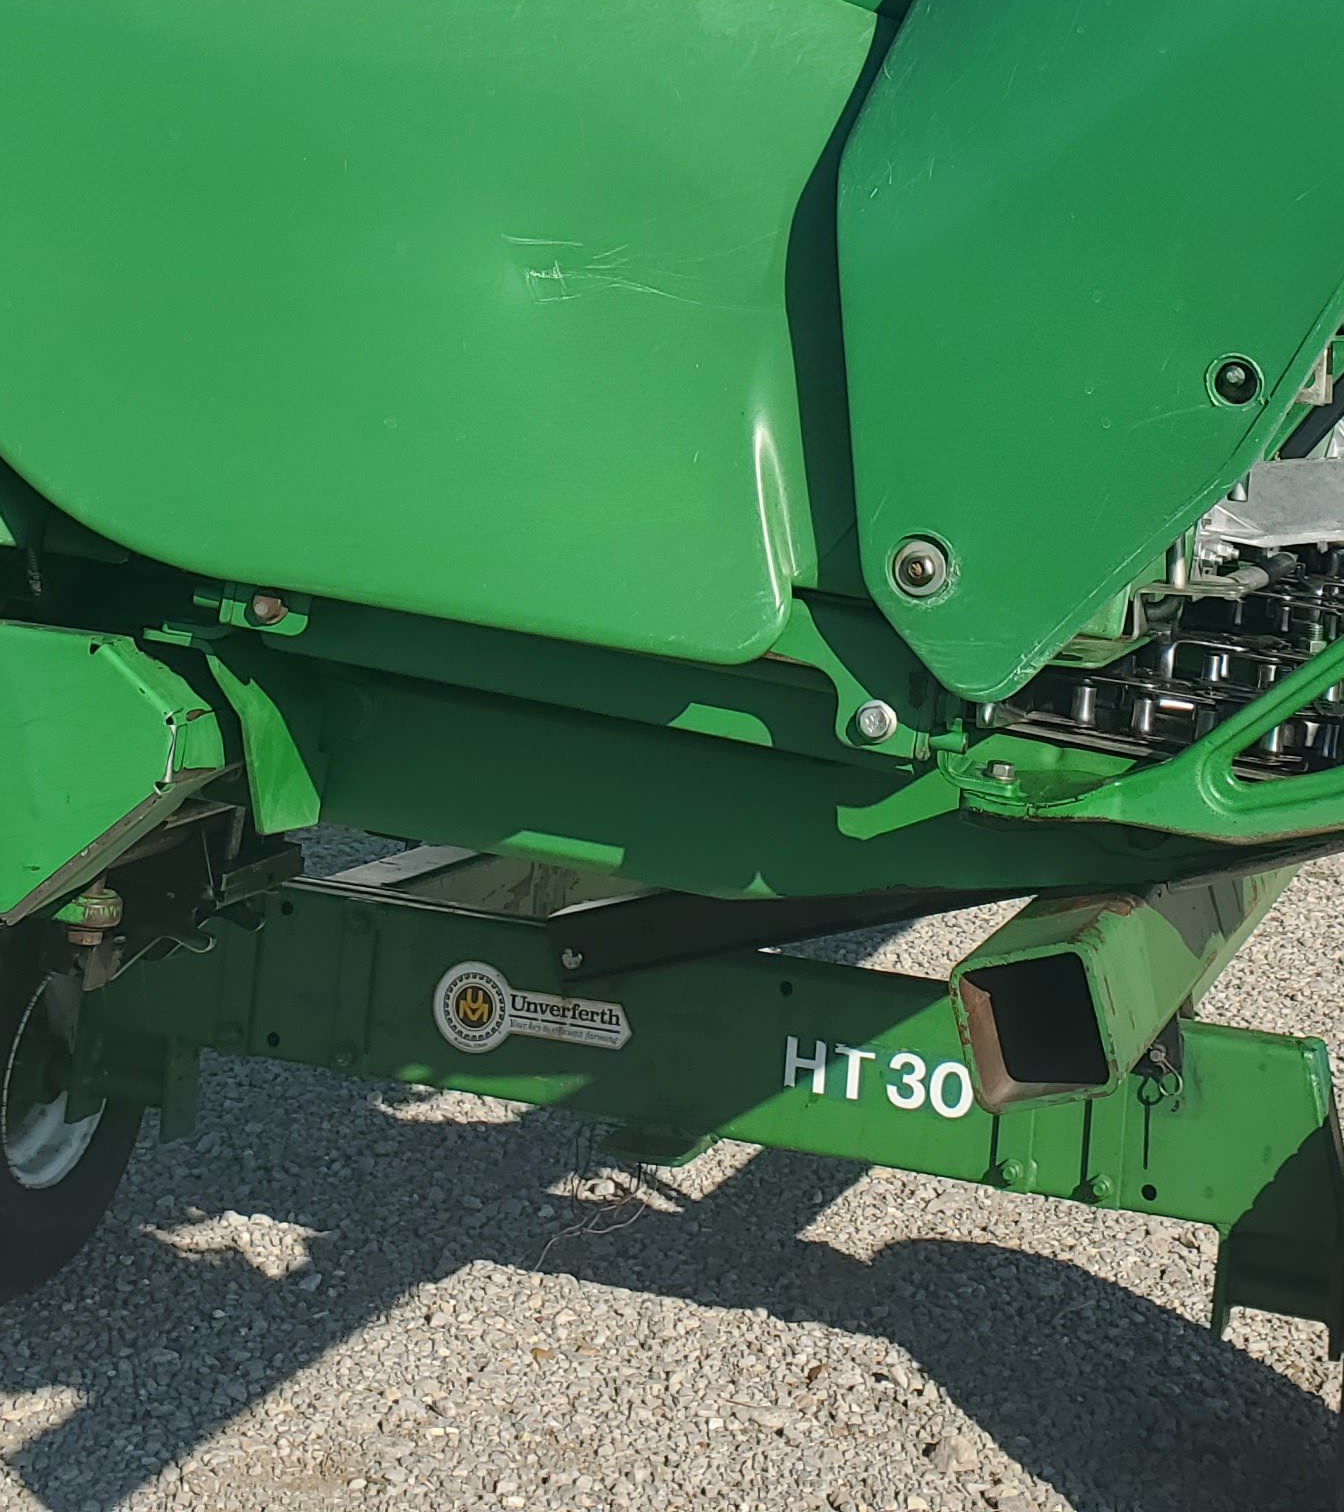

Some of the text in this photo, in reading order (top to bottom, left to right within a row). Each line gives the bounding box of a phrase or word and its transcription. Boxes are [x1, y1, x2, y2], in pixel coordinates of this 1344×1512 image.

[509, 993, 621, 1026] Unverferth
[782, 1034, 974, 1119] HT 30
